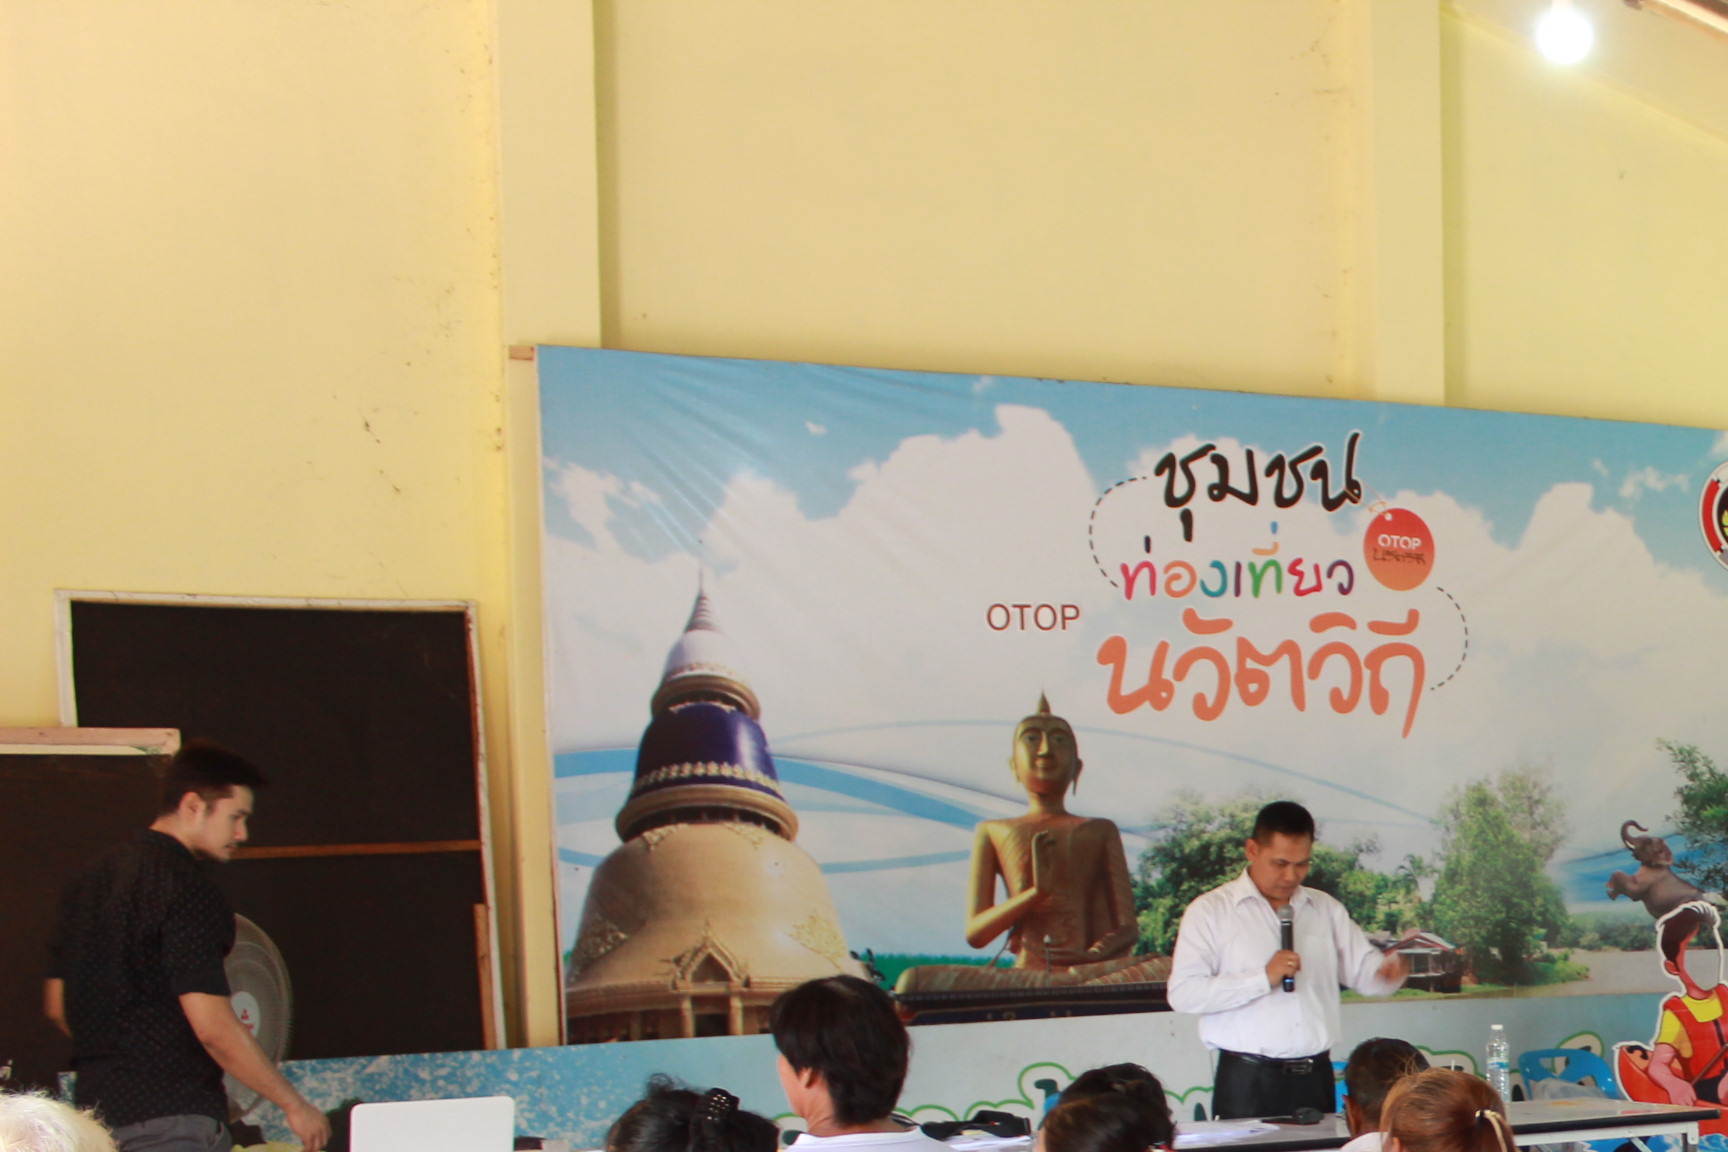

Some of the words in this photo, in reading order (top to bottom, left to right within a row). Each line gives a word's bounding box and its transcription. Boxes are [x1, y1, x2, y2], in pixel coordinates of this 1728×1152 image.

[1154, 431, 1363, 542] ชุมชน
[1119, 520, 1355, 600] ท่องเที่ยว
[1378, 533, 1422, 550] OTOP
[986, 603, 1081, 631] OTOP
[1096, 607, 1426, 739] นวัตวิถี
